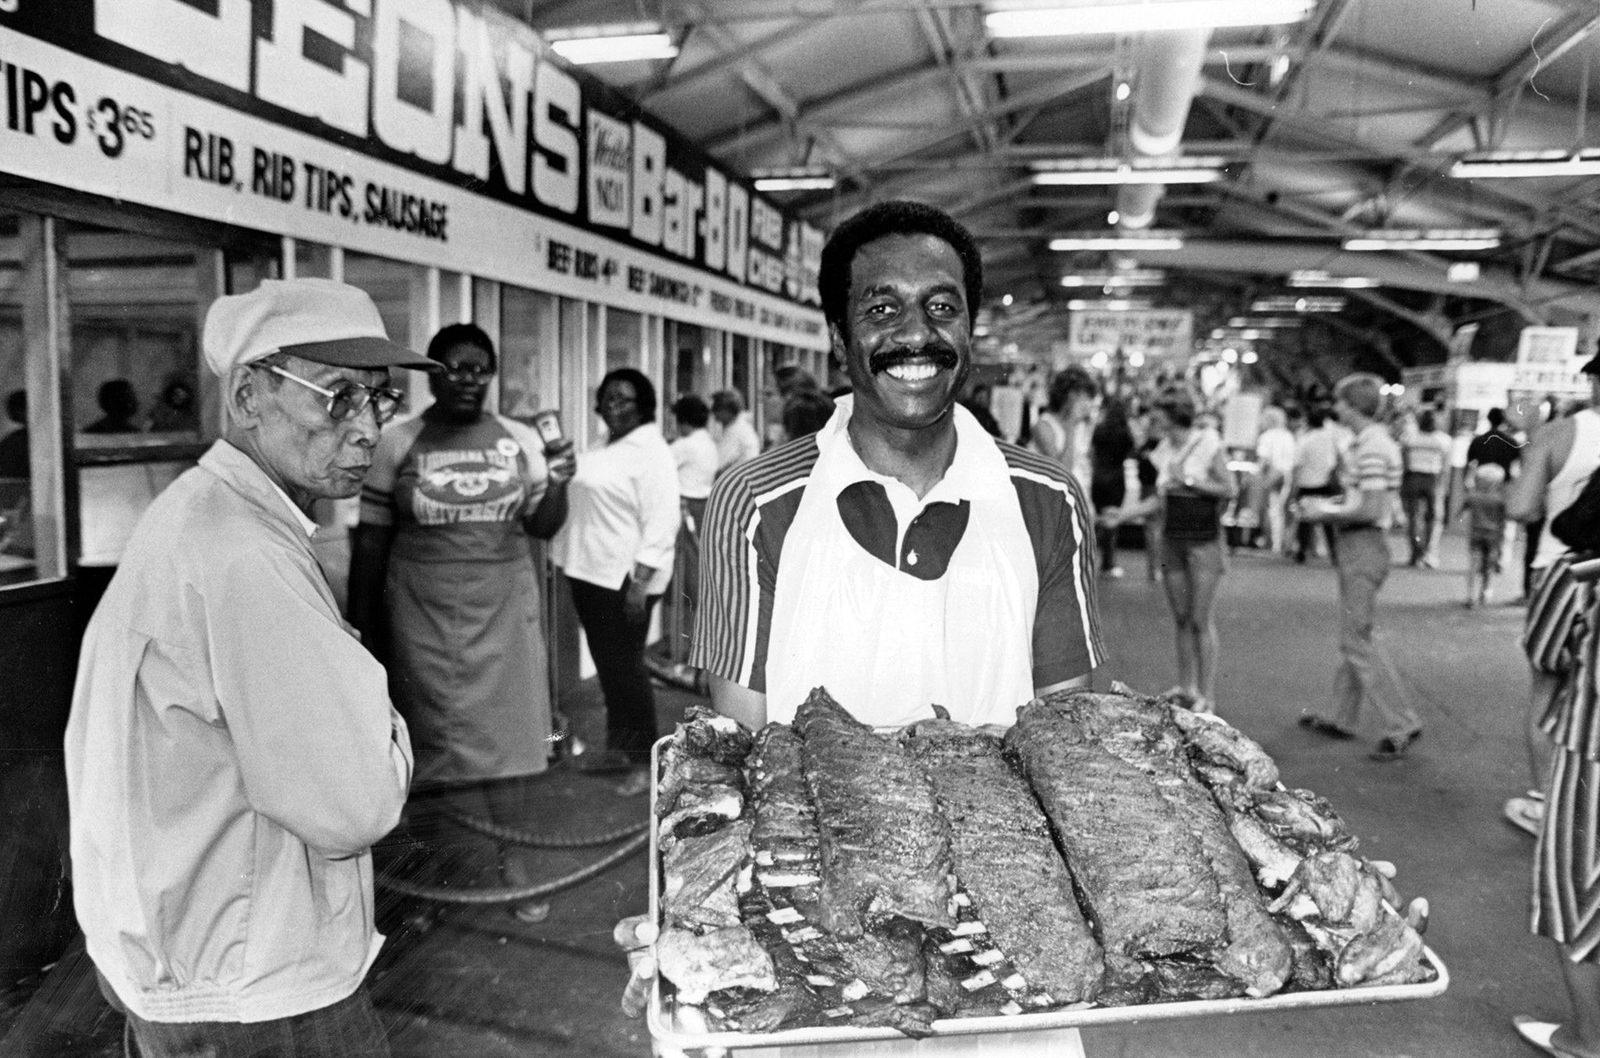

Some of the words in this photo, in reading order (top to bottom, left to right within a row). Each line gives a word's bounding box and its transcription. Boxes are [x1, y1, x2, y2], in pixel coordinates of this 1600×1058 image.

[0, 59, 76, 145] IPS
[253, 147, 295, 203] RIB
[364, 182, 448, 242] SAUSAGE
